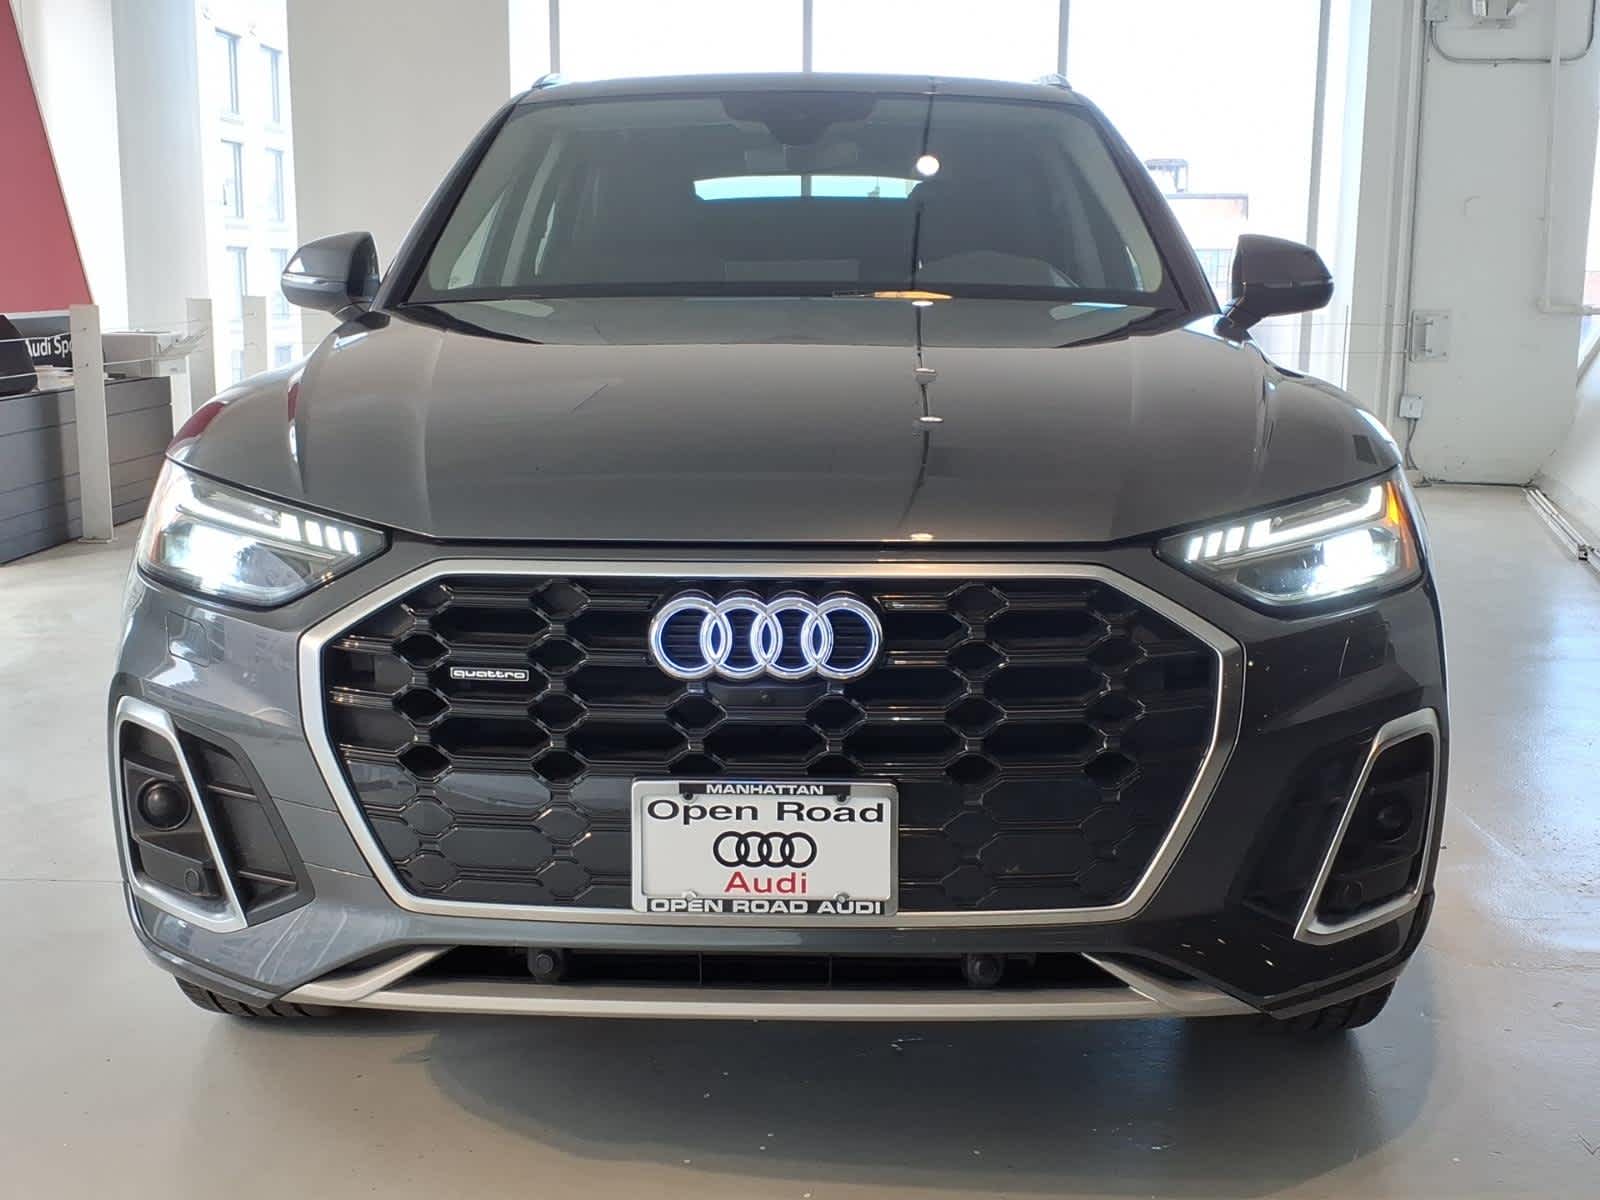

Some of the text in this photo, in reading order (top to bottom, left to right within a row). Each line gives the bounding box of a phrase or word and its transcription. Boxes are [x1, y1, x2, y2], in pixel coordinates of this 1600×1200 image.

[453, 670, 525, 679] quattro
[706, 784, 824, 795] MANHATTAN
[647, 800, 884, 825] Open Road
[724, 871, 808, 893] Audi
[650, 899, 881, 914] OPEN ROAD AUDI
